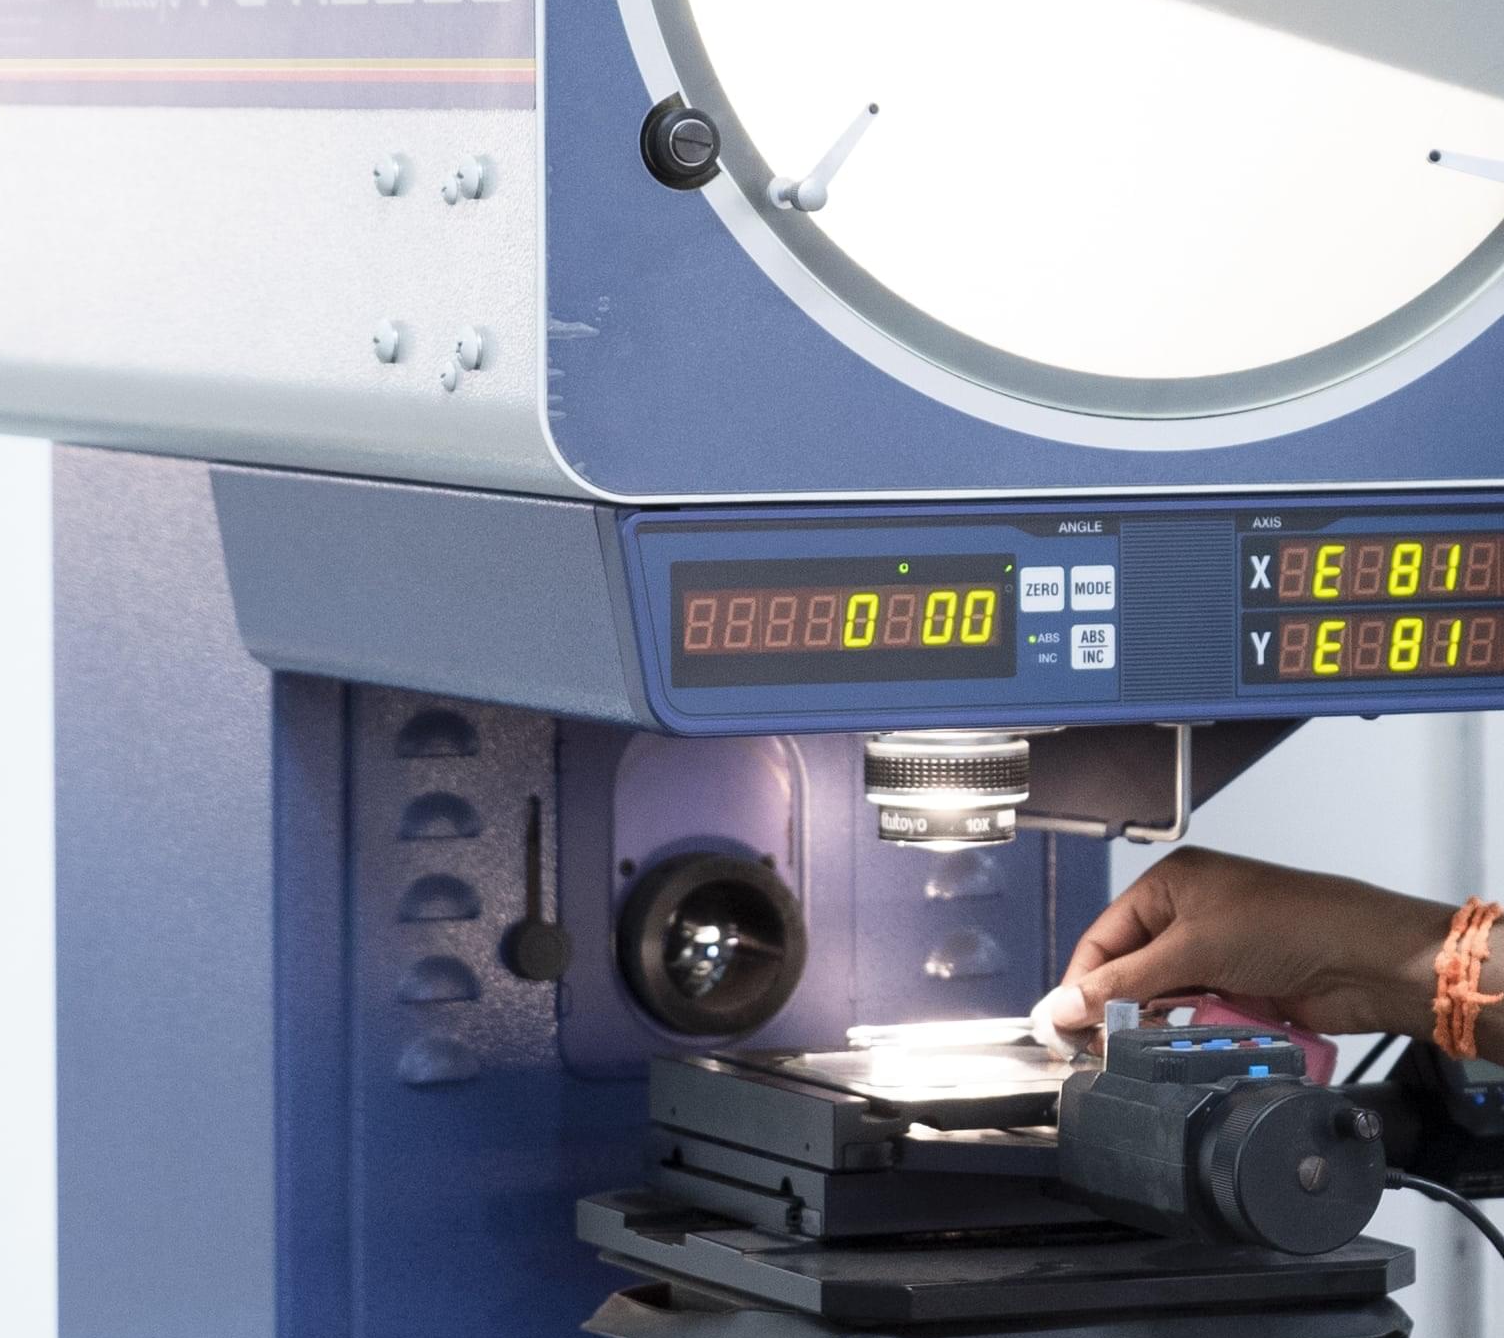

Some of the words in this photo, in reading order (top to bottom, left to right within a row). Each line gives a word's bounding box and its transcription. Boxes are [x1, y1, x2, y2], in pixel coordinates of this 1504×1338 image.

[1058, 521, 1103, 533] ANGLE
[1253, 516, 1282, 529] AXIS
[1250, 555, 1272, 589] X
[1312, 544, 1345, 598] E
[1388, 542, 1462, 597] 81
[1026, 583, 1059, 596] ZERO
[1075, 581, 1112, 595] MODE
[1038, 633, 1060, 643] ABS
[1080, 630, 1105, 643] ABS
[1250, 631, 1271, 664] Y
[1312, 620, 1346, 674] E
[1388, 618, 1462, 671] 81
[1038, 653, 1057, 663] INC
[1082, 650, 1104, 663] INC
[965, 817, 990, 833] 10X
